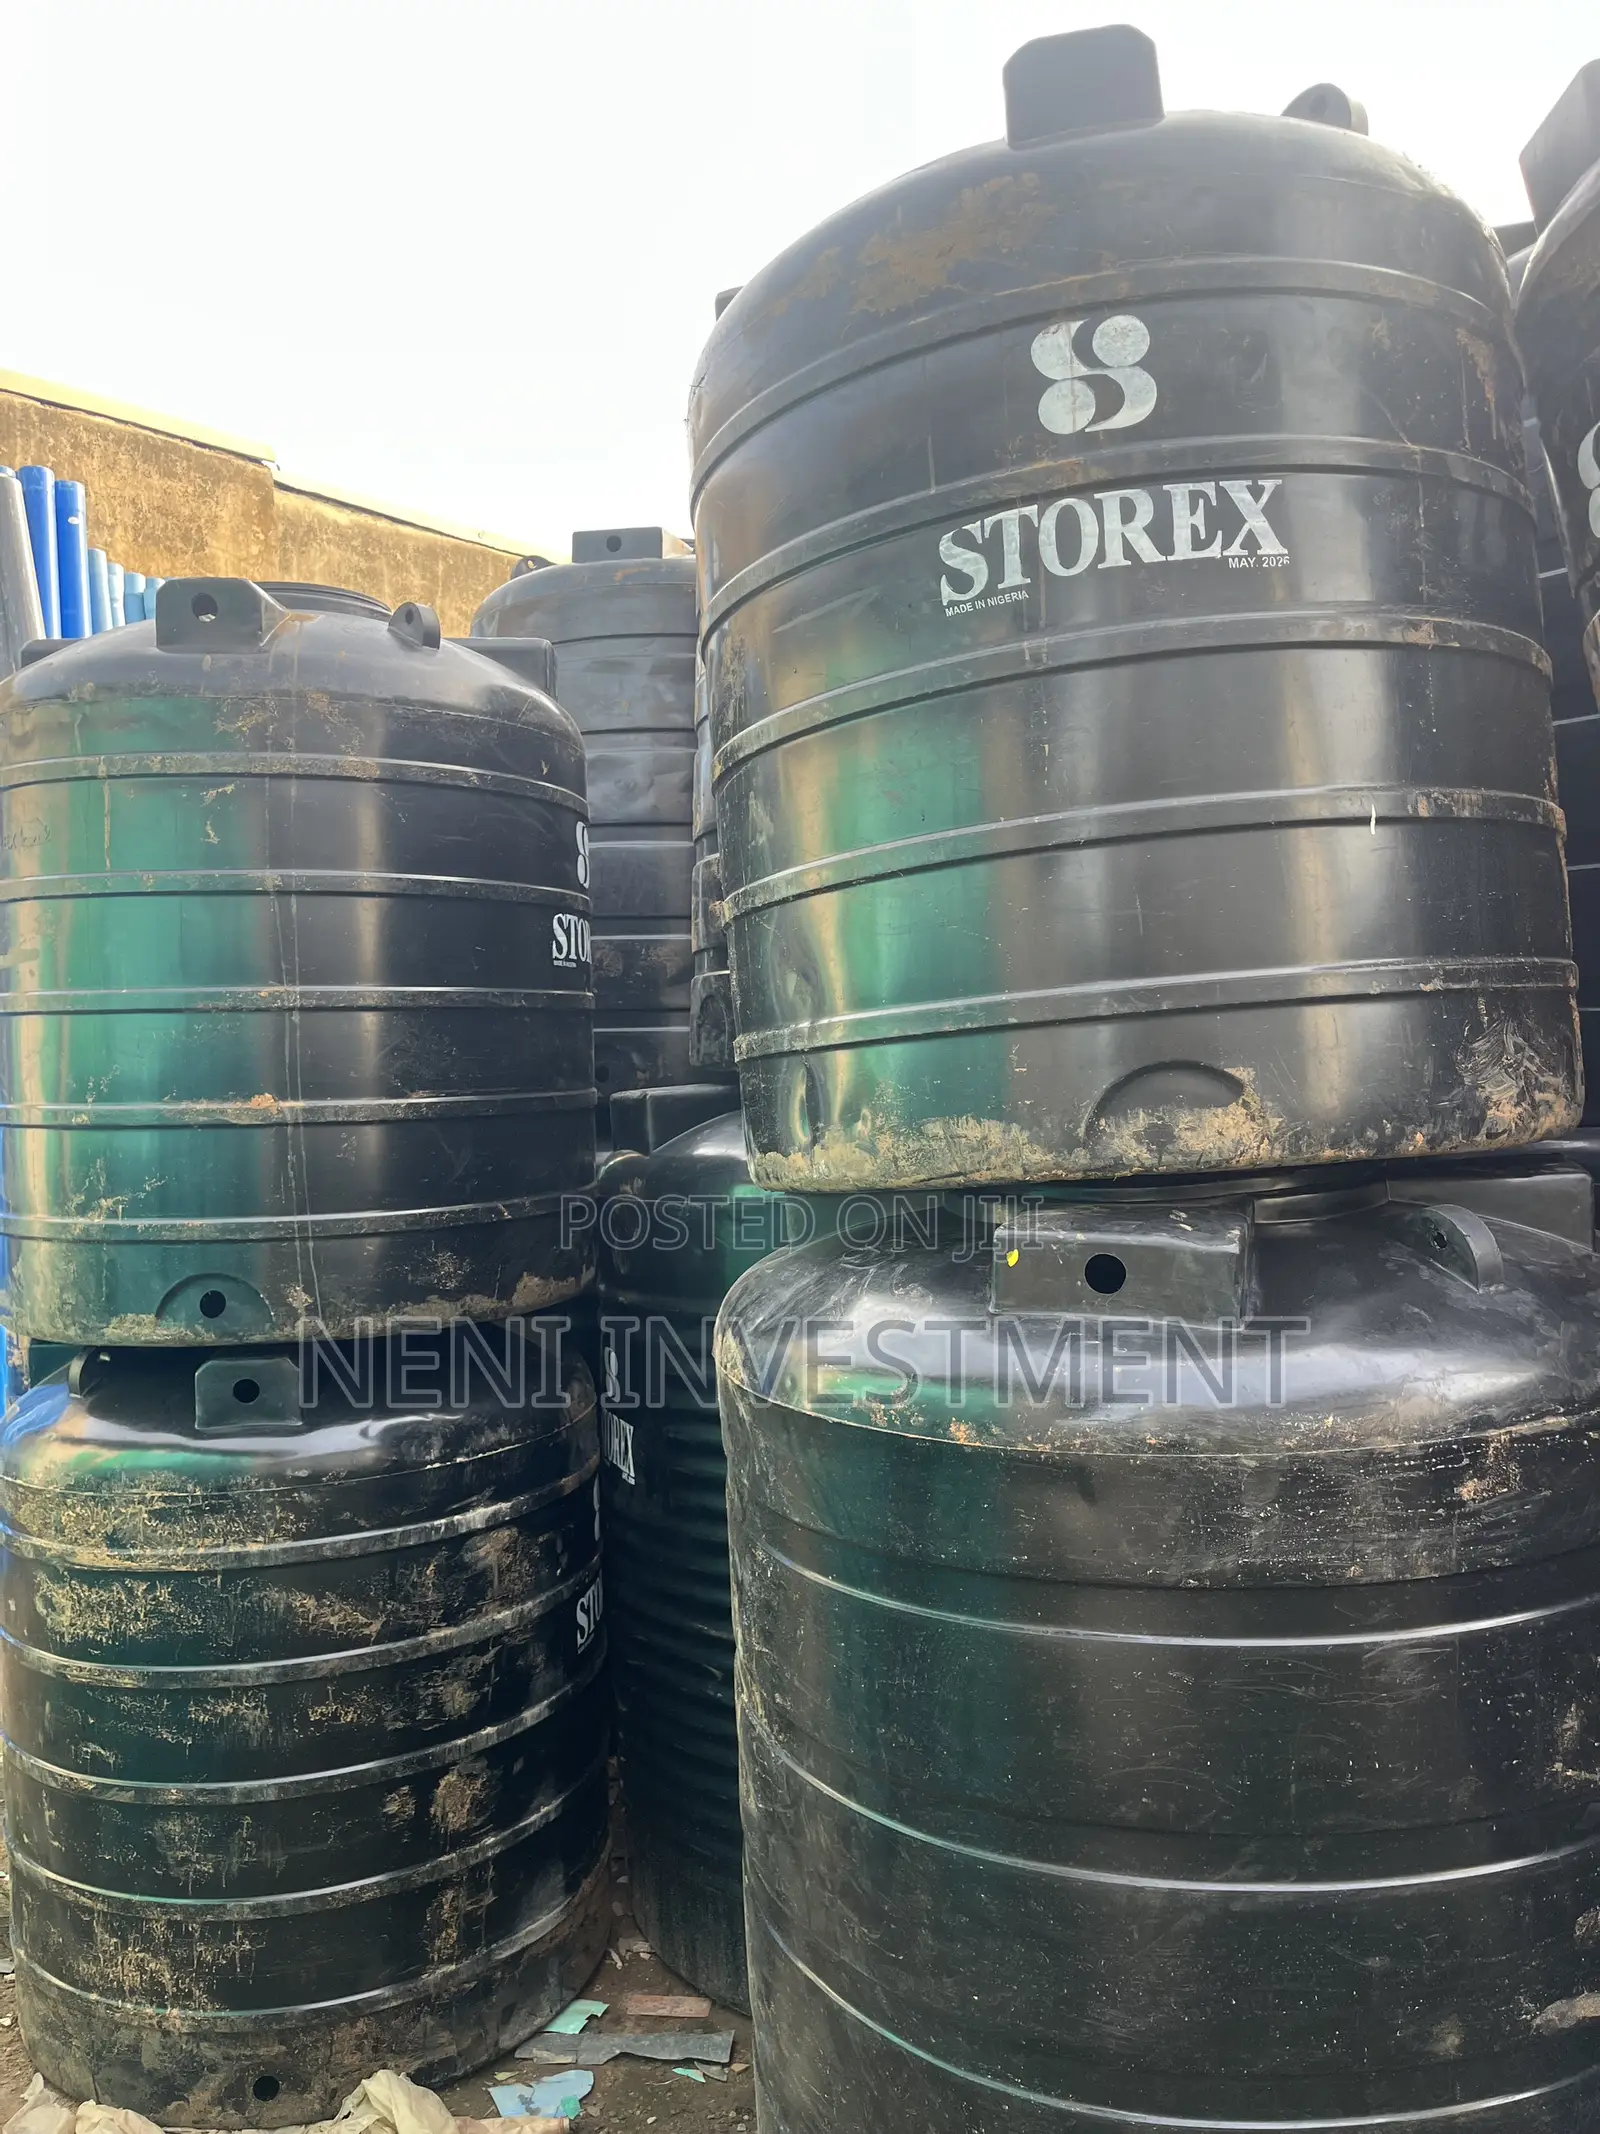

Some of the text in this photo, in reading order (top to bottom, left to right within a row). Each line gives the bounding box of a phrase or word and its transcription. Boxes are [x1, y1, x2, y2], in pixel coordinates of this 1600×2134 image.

[938, 479, 1289, 606] STOREX
[945, 590, 1030, 617] MADE IN NIGERIA
